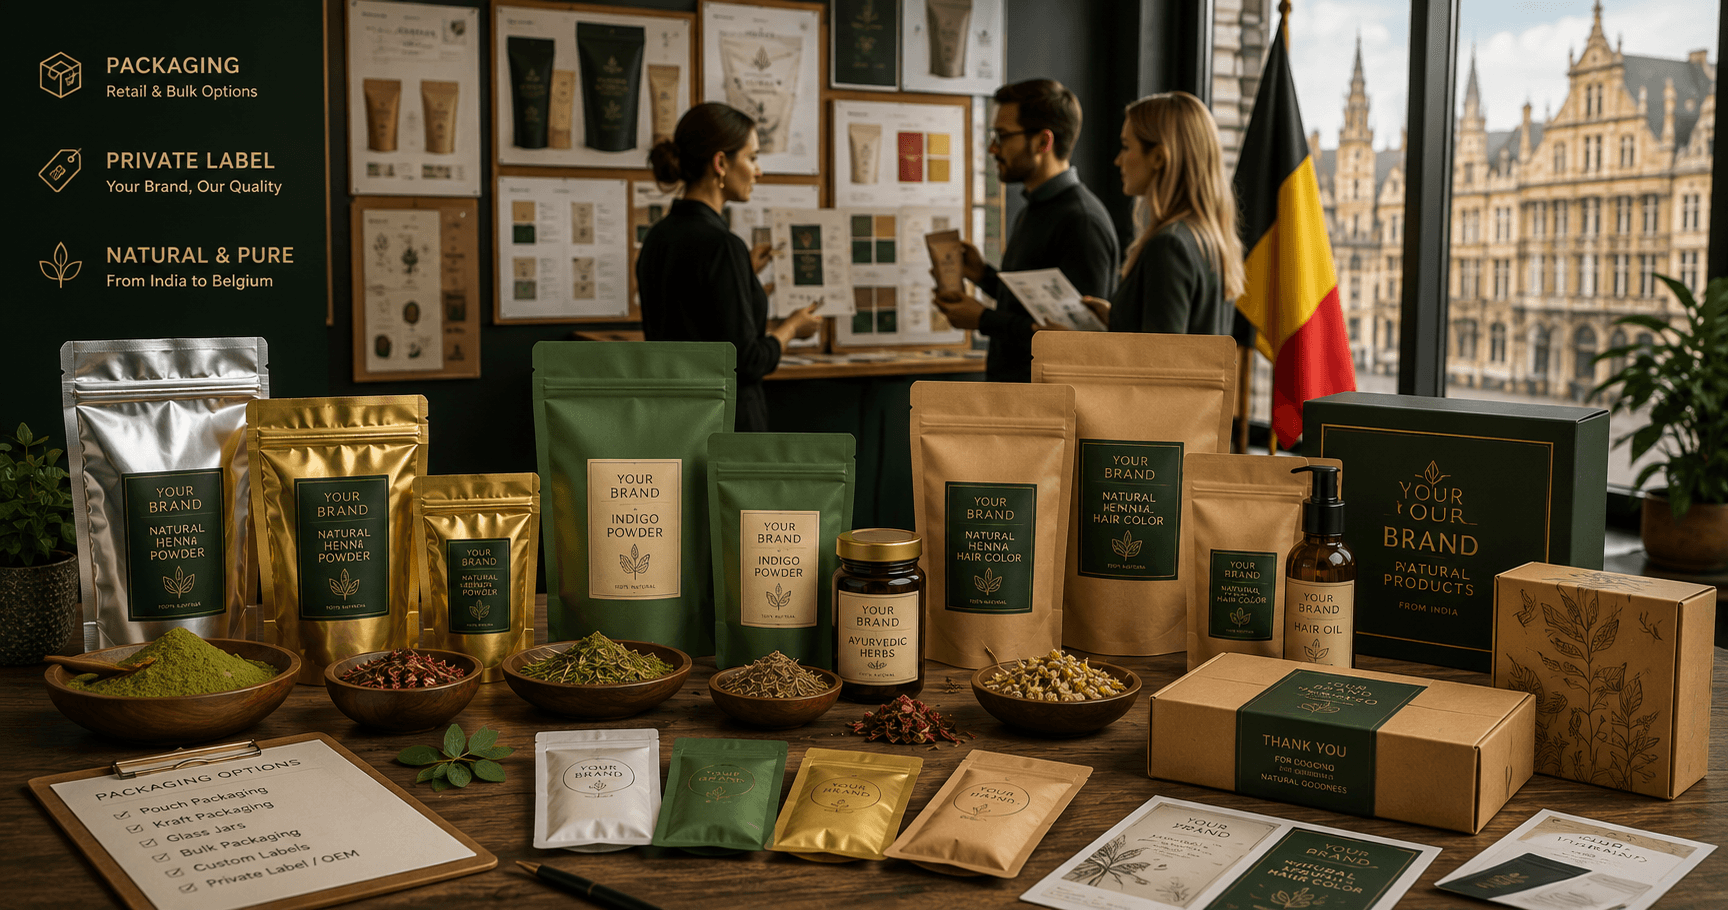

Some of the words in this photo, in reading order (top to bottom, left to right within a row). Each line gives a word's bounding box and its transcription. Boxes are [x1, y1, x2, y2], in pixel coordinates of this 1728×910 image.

[1113, 455, 1148, 466] YOUR
[617, 474, 653, 484] YOUR
[1105, 468, 1155, 480] BRAND
[156, 486, 194, 498] YOUR
[324, 491, 360, 502] YOUR
[610, 487, 660, 498] BRAND
[1103, 492, 1156, 503] NATURAL
[1399, 480, 1463, 505] YOUR
[149, 499, 202, 513] BRAND
[974, 496, 1007, 507] YOUR
[317, 504, 368, 517] BRAND
[967, 509, 1015, 520] BRAND
[611, 514, 659, 524] INDIGO
[1093, 514, 1120, 524] HAIR
[1124, 515, 1164, 526] COLOR
[149, 524, 205, 536] NATURAL
[764, 522, 796, 531] YOUR
[318, 528, 371, 539] NATURAL
[607, 527, 663, 538] POWDER
[965, 531, 1015, 541] NATURAL
[156, 536, 197, 548] HENNA
[758, 534, 801, 544] BRAND
[1384, 525, 1479, 556] BRAND
[324, 539, 364, 551] HENNA
[968, 541, 1009, 551] HENNA
[150, 547, 205, 561] POWDER
[319, 551, 370, 563] POWDER
[467, 548, 491, 557] YOUR
[957, 552, 982, 562] HAIR
[985, 553, 1022, 563] COLOR
[462, 557, 497, 567] BRAND
[758, 556, 800, 566] INDIGO
[1230, 561, 1255, 570] YOUR
[755, 568, 803, 578] POWDER
[1384, 573, 1474, 596] PRODUCTS
[1238, 596, 1267, 604] COLOR
[1304, 592, 1333, 603] YOUR
[862, 605, 894, 615] YOUR
[1299, 603, 1340, 614] BRAND
[1399, 601, 1427, 613] FROM
[1431, 605, 1458, 616] INDIA
[856, 617, 900, 627] BRAND
[1294, 621, 1319, 634] HAIR
[1323, 625, 1342, 635] OIL
[848, 636, 907, 647] AYURVEDIC
[860, 649, 895, 658] HERBS
[1263, 733, 1312, 752] THANK
[1316, 742, 1347, 758] YOU
[1274, 755, 1292, 764] FOR
[95, 774, 212, 802] PACKAGING
[217, 758, 301, 779] OPTIONS
[575, 771, 623, 779] BRAND
[1261, 773, 1299, 786] NATURAL
[1301, 780, 1347, 794] GOODNESS
[139, 801, 189, 815] Pouch
[190, 786, 269, 805] Packaging
[152, 815, 194, 829] Kraft
[195, 800, 275, 821] Packaging
[1188, 817, 1228, 830] YOUR
[166, 828, 210, 843] Glass
[215, 822, 247, 834] Jars
[179, 843, 216, 858] Bulk
[220, 829, 301, 850] Packaging
[1325, 843, 1369, 857] YOUR
[193, 854, 256, 873] Custom
[257, 843, 311, 859] Labels
[206, 870, 263, 888] Private
[265, 859, 310, 876] Label
[312, 857, 318, 867] /
[321, 849, 361, 863] OEM
[1312, 878, 1363, 894] COLOR
